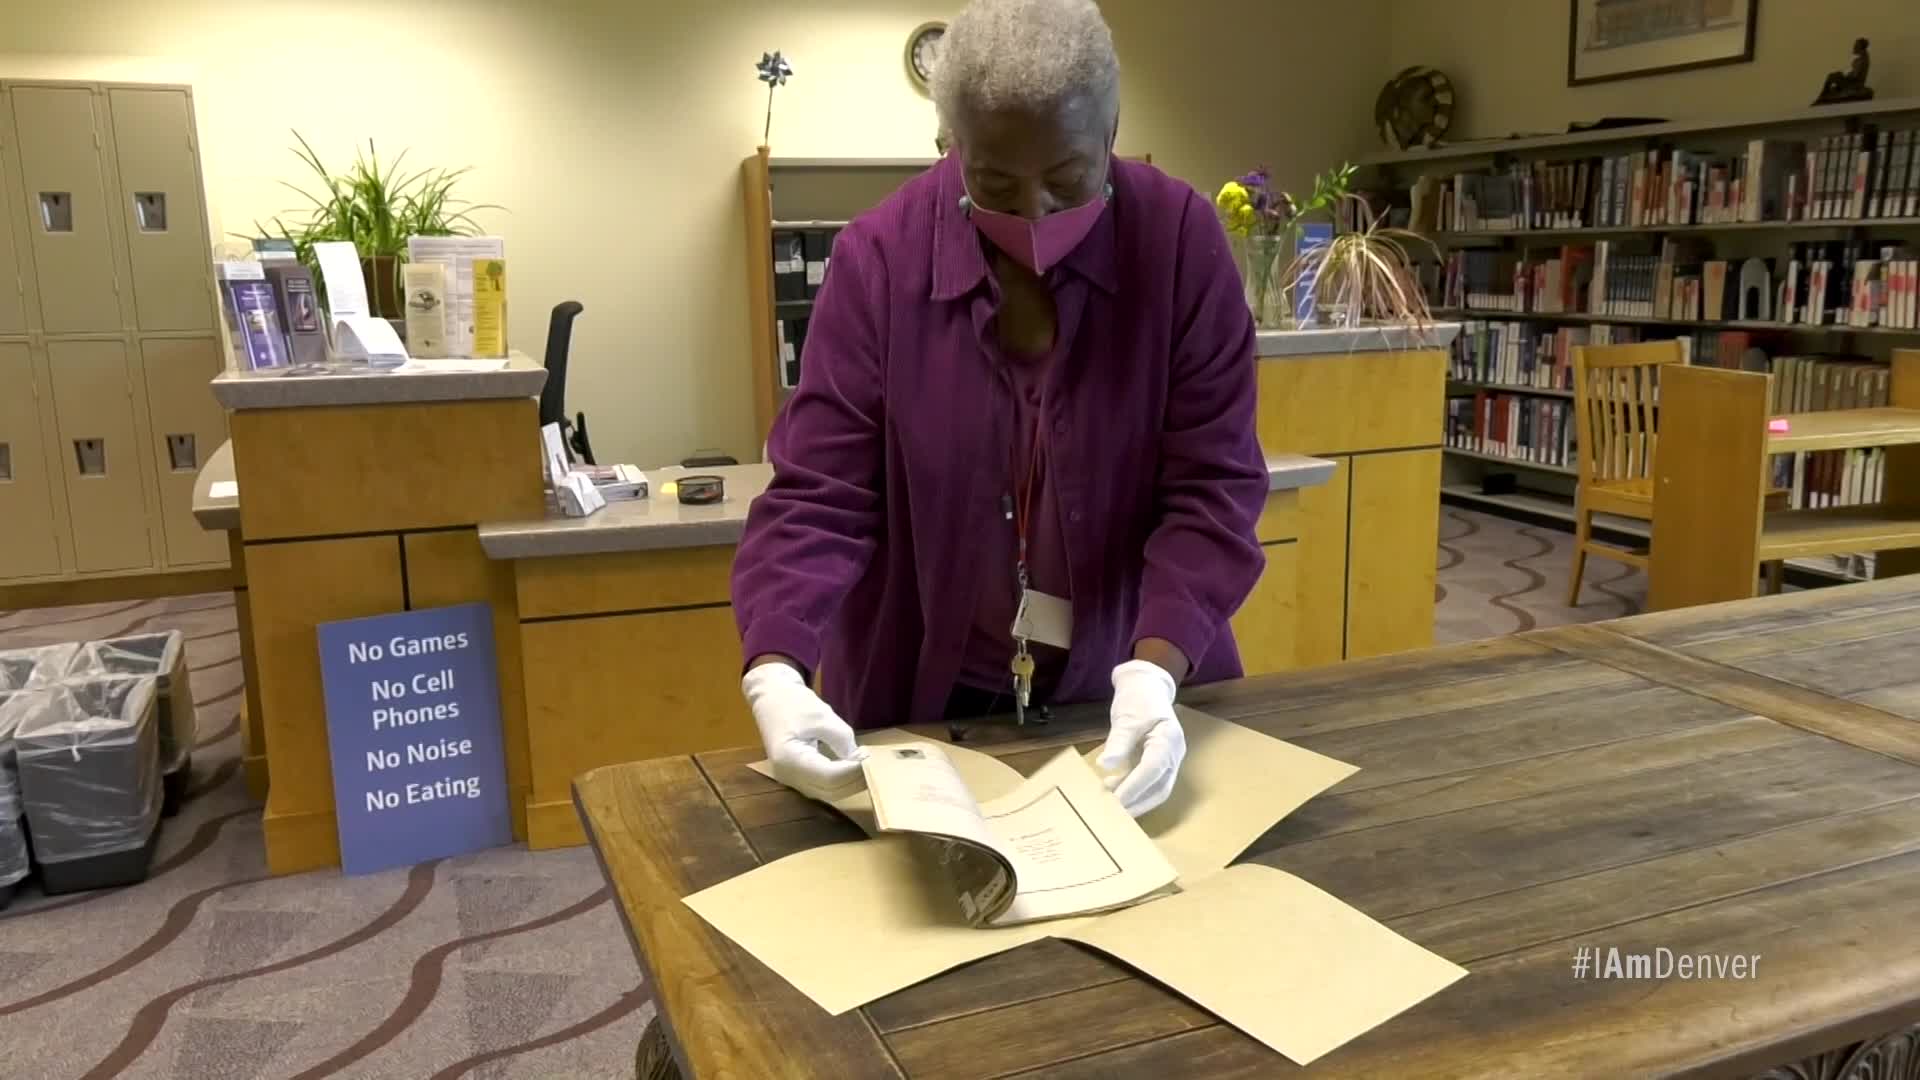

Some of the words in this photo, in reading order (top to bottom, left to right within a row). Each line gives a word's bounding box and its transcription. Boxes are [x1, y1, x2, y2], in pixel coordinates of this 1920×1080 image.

[348, 642, 383, 664] No
[390, 632, 468, 657] Games
[371, 678, 405, 701] No
[412, 669, 454, 694] Cell
[372, 702, 459, 730] Phones
[367, 749, 400, 772] No
[407, 739, 472, 764] Noise
[366, 790, 399, 812] No
[406, 776, 480, 804] Eating
